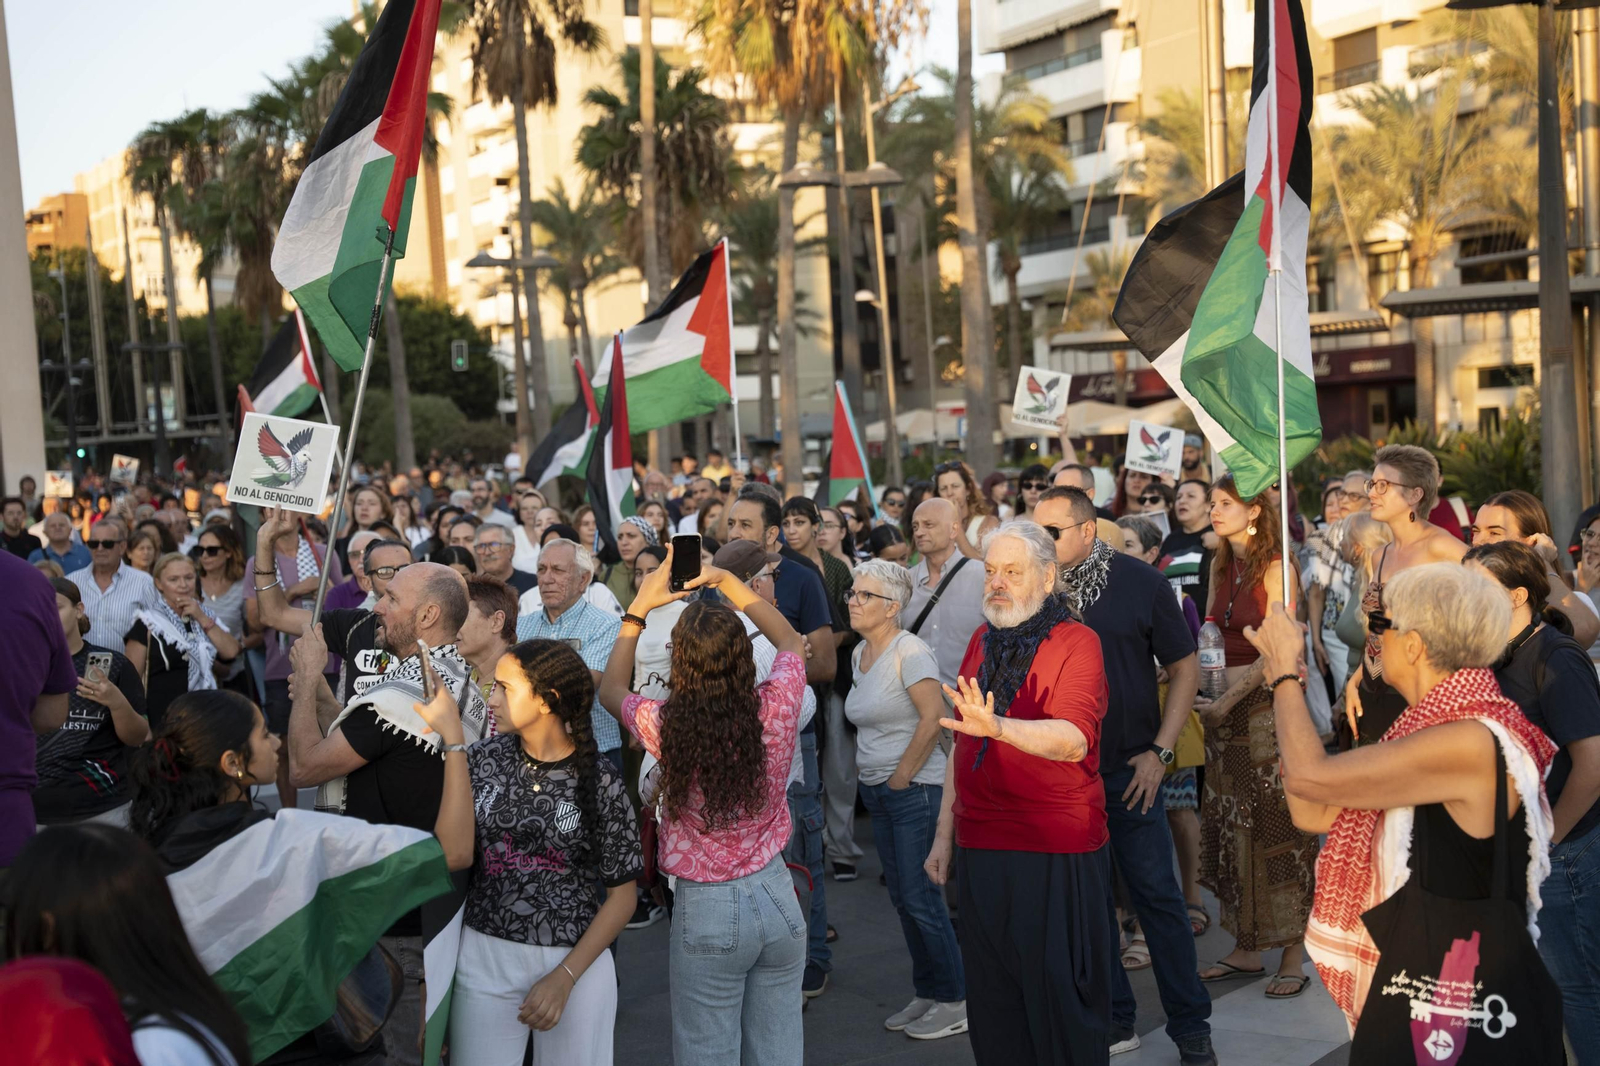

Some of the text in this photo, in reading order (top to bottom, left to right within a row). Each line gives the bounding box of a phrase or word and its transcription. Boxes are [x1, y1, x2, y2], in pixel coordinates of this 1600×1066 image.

[1129, 460, 1138, 468] NO
[234, 486, 314, 507] NO AL GENOCIDIO
